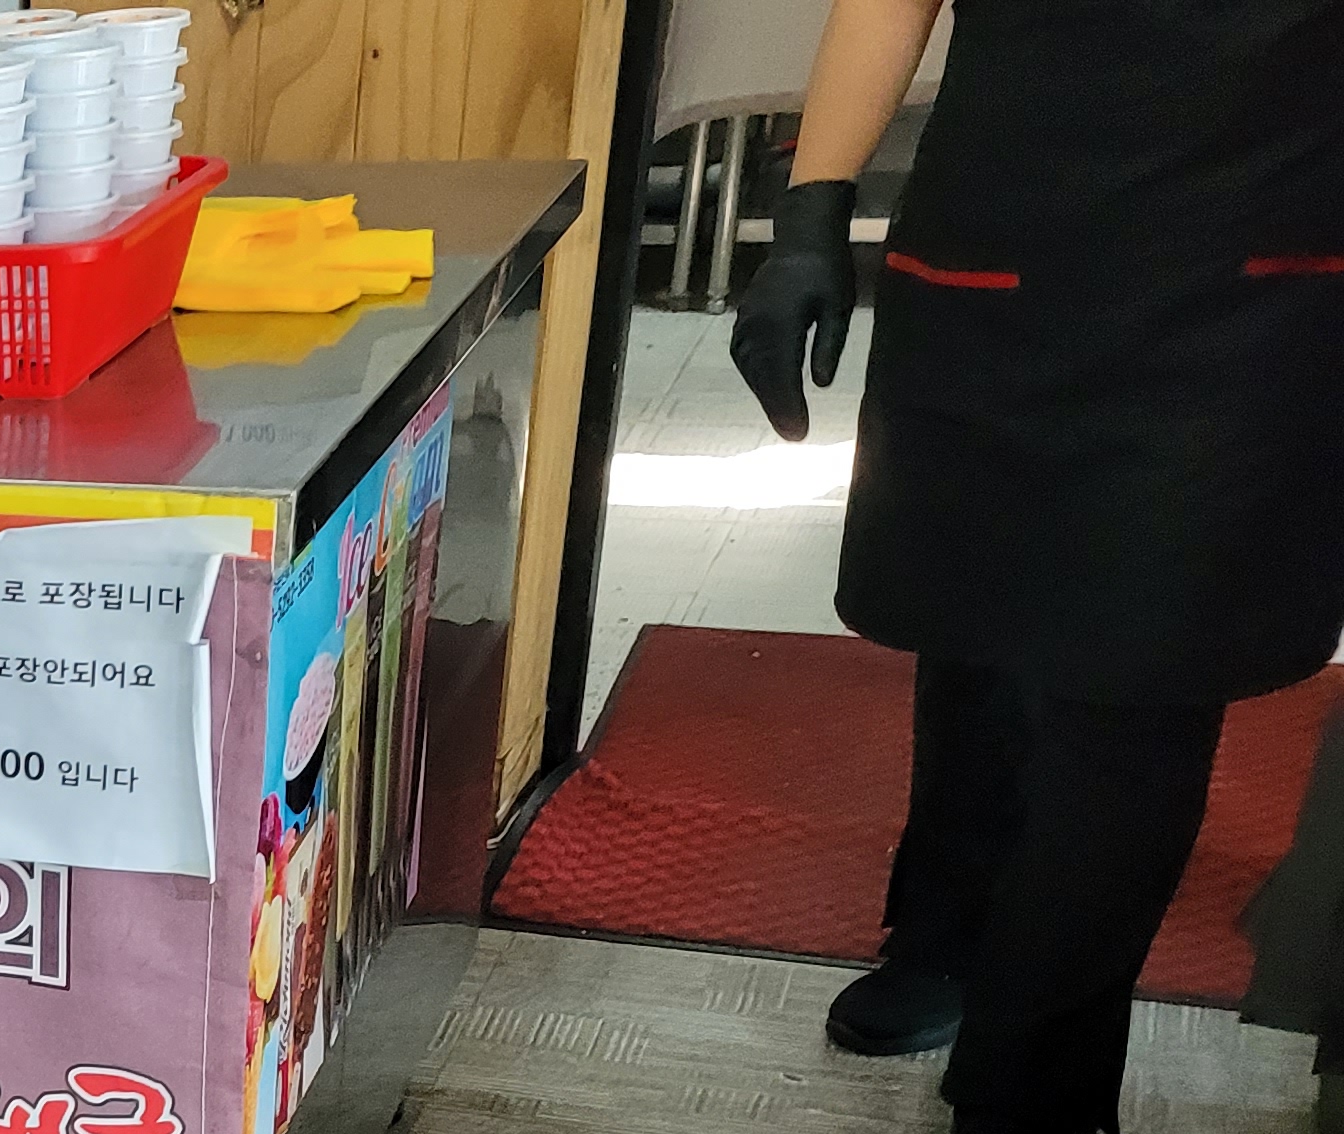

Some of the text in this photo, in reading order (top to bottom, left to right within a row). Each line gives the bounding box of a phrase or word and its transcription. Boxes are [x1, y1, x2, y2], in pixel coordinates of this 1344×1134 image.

[336, 511, 374, 633] Ice
[39, 579, 186, 615] 포장됩니다
[57, 759, 140, 794] 입니다
